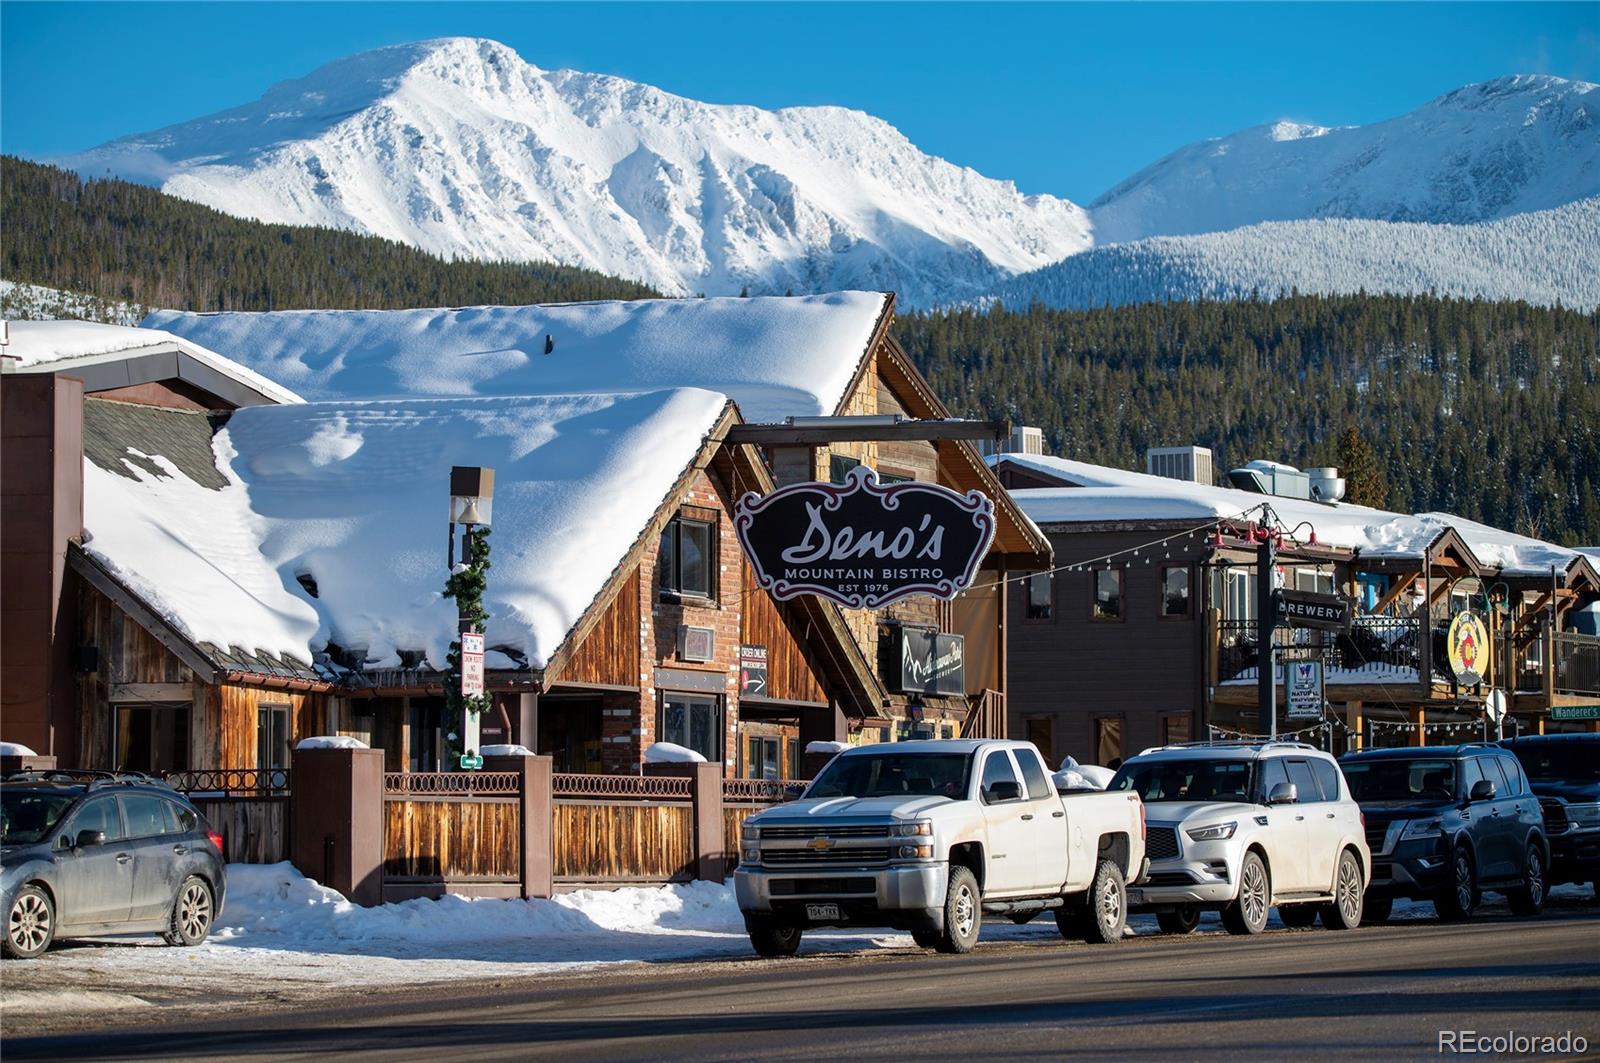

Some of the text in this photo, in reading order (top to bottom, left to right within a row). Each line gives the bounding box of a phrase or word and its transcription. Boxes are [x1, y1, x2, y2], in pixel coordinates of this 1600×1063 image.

[781, 500, 945, 564] Deno's
[784, 567, 944, 580] MOUNTAIN BISTRO
[838, 584, 889, 592] EST 1976
[1278, 602, 1342, 619] BREWERY
